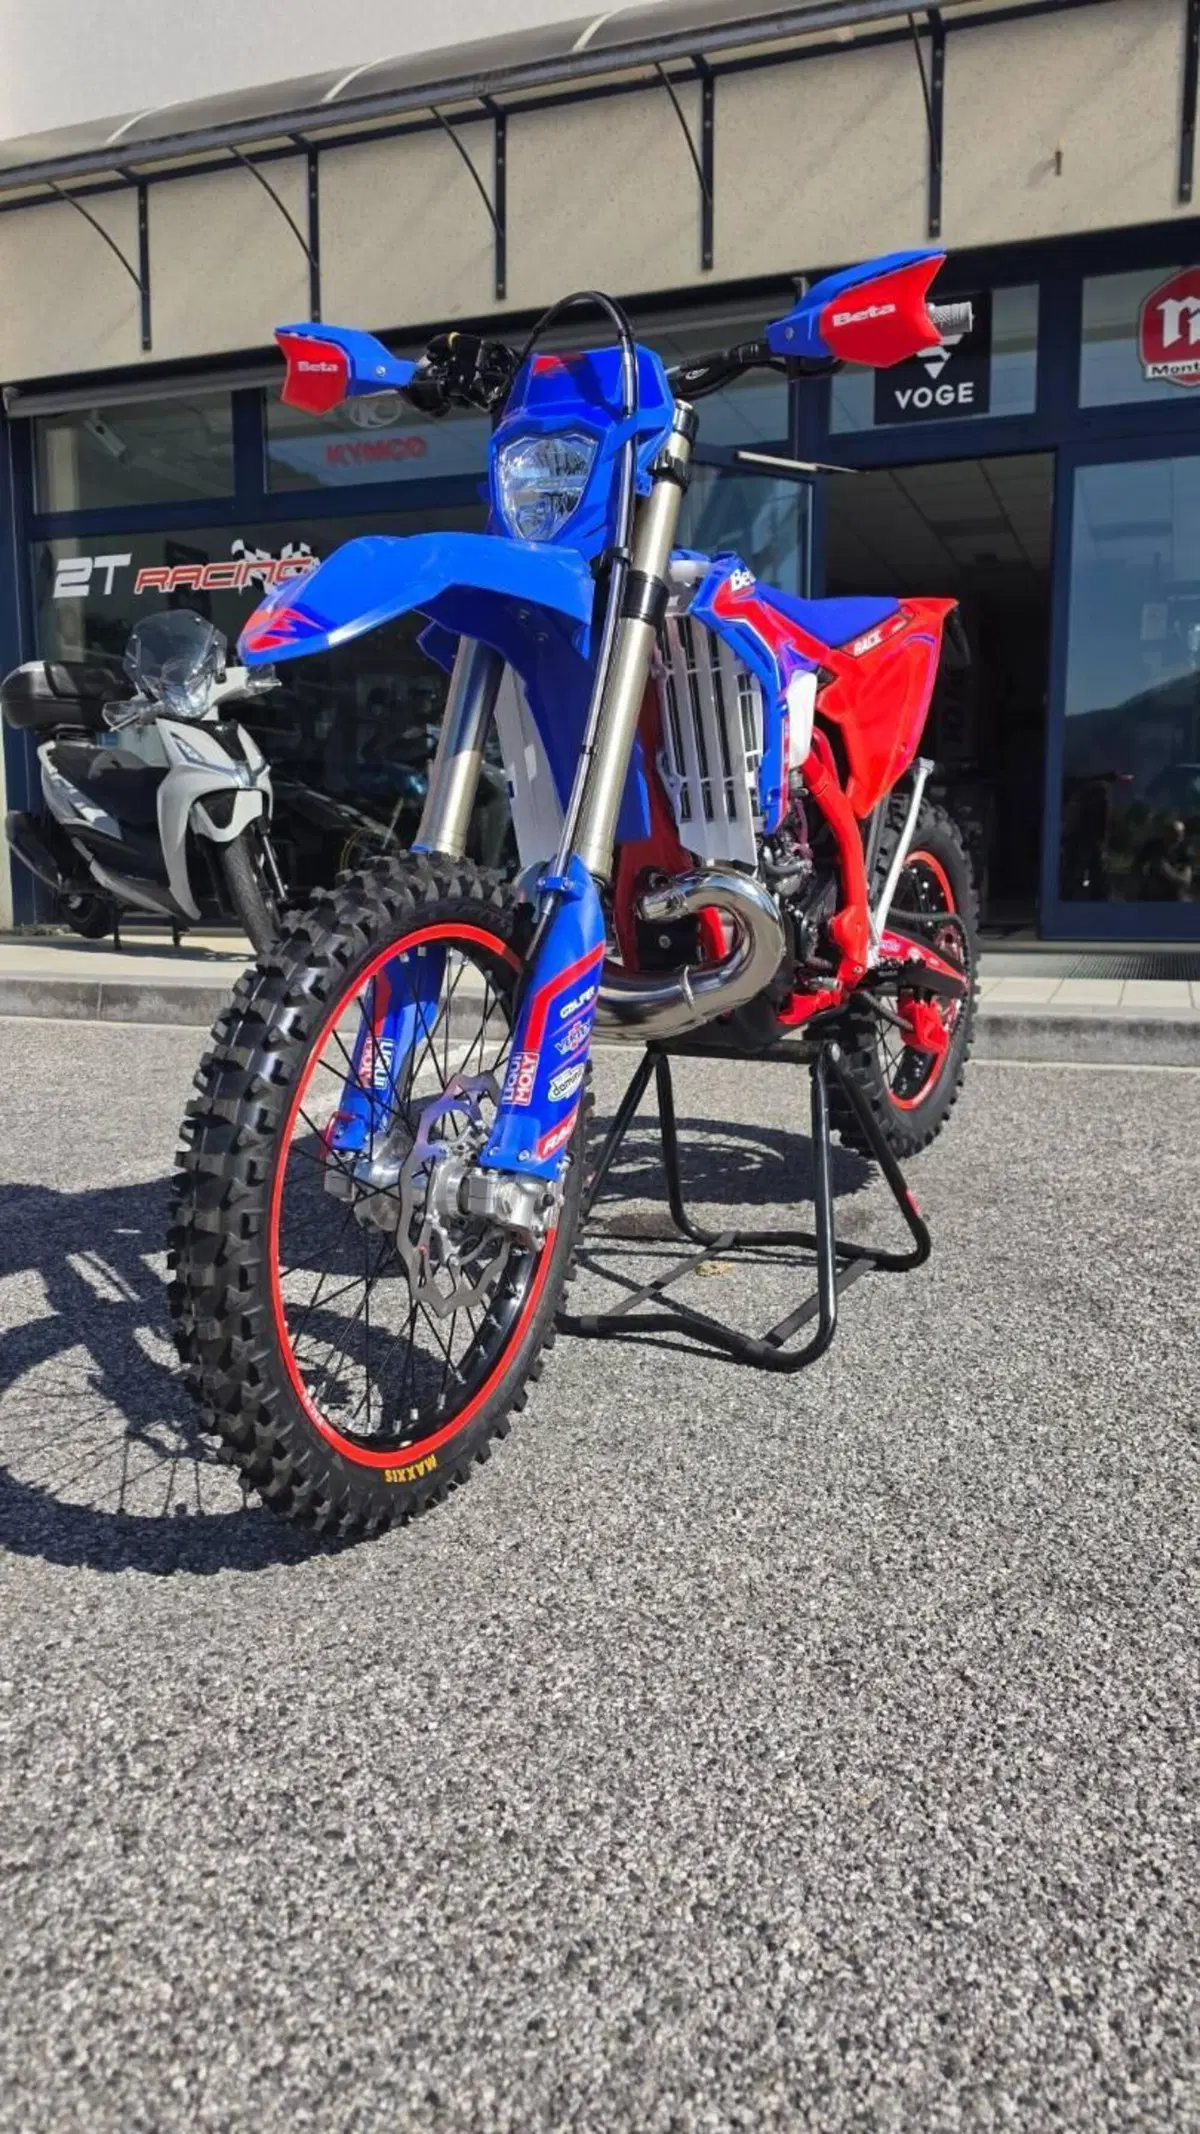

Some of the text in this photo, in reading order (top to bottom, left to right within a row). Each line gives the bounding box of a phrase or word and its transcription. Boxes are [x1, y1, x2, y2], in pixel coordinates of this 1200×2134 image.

[832, 304, 897, 327] Beta
[297, 360, 339, 373] Beta
[894, 382, 974, 410] VOGE
[325, 435, 427, 466] KYMCO
[53, 553, 132, 598] 2T
[502, 1054, 522, 1104] LIQUI
[514, 1054, 536, 1104] MOLY
[384, 1453, 438, 1484] MAXXIS
